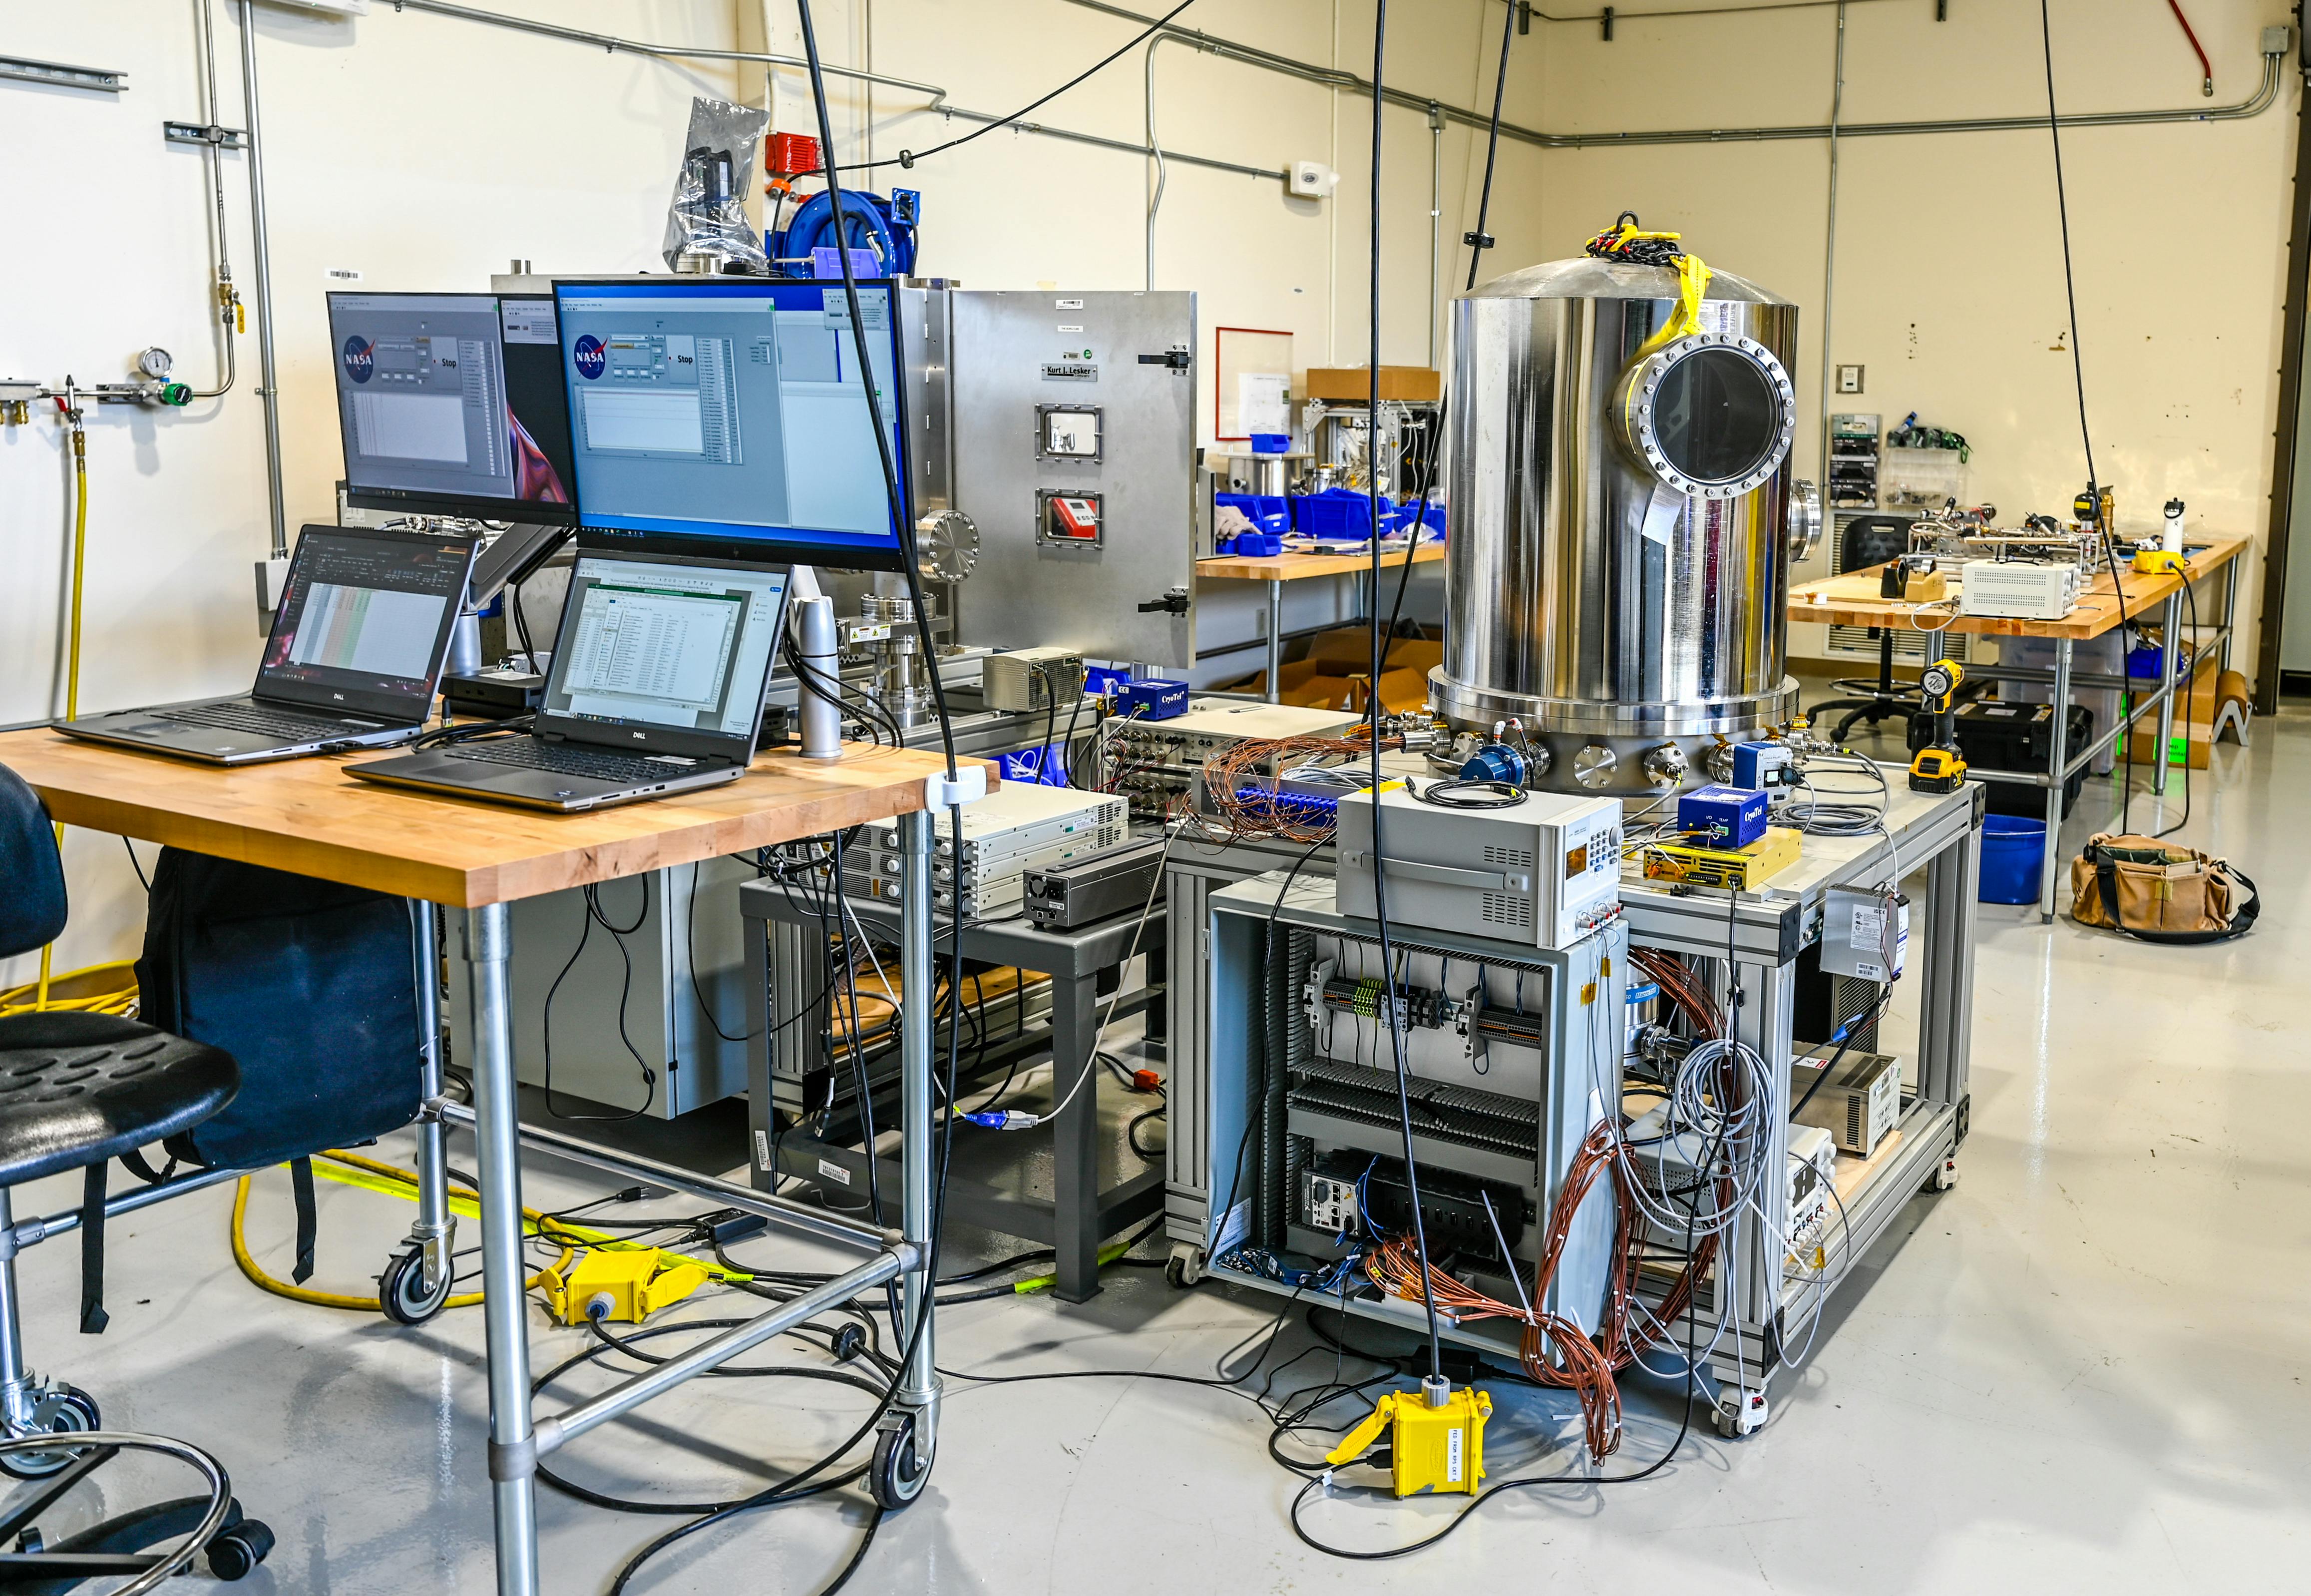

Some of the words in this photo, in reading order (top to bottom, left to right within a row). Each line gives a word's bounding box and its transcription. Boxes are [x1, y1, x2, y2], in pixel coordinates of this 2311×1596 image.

[346, 354, 372, 366] NASA
[576, 352, 604, 363] NASA
[678, 355, 693, 365] Stop
[442, 358, 456, 369] Stop
[1063, 367, 1068, 375] J.
[1744, 805, 1762, 822] CryoTel
